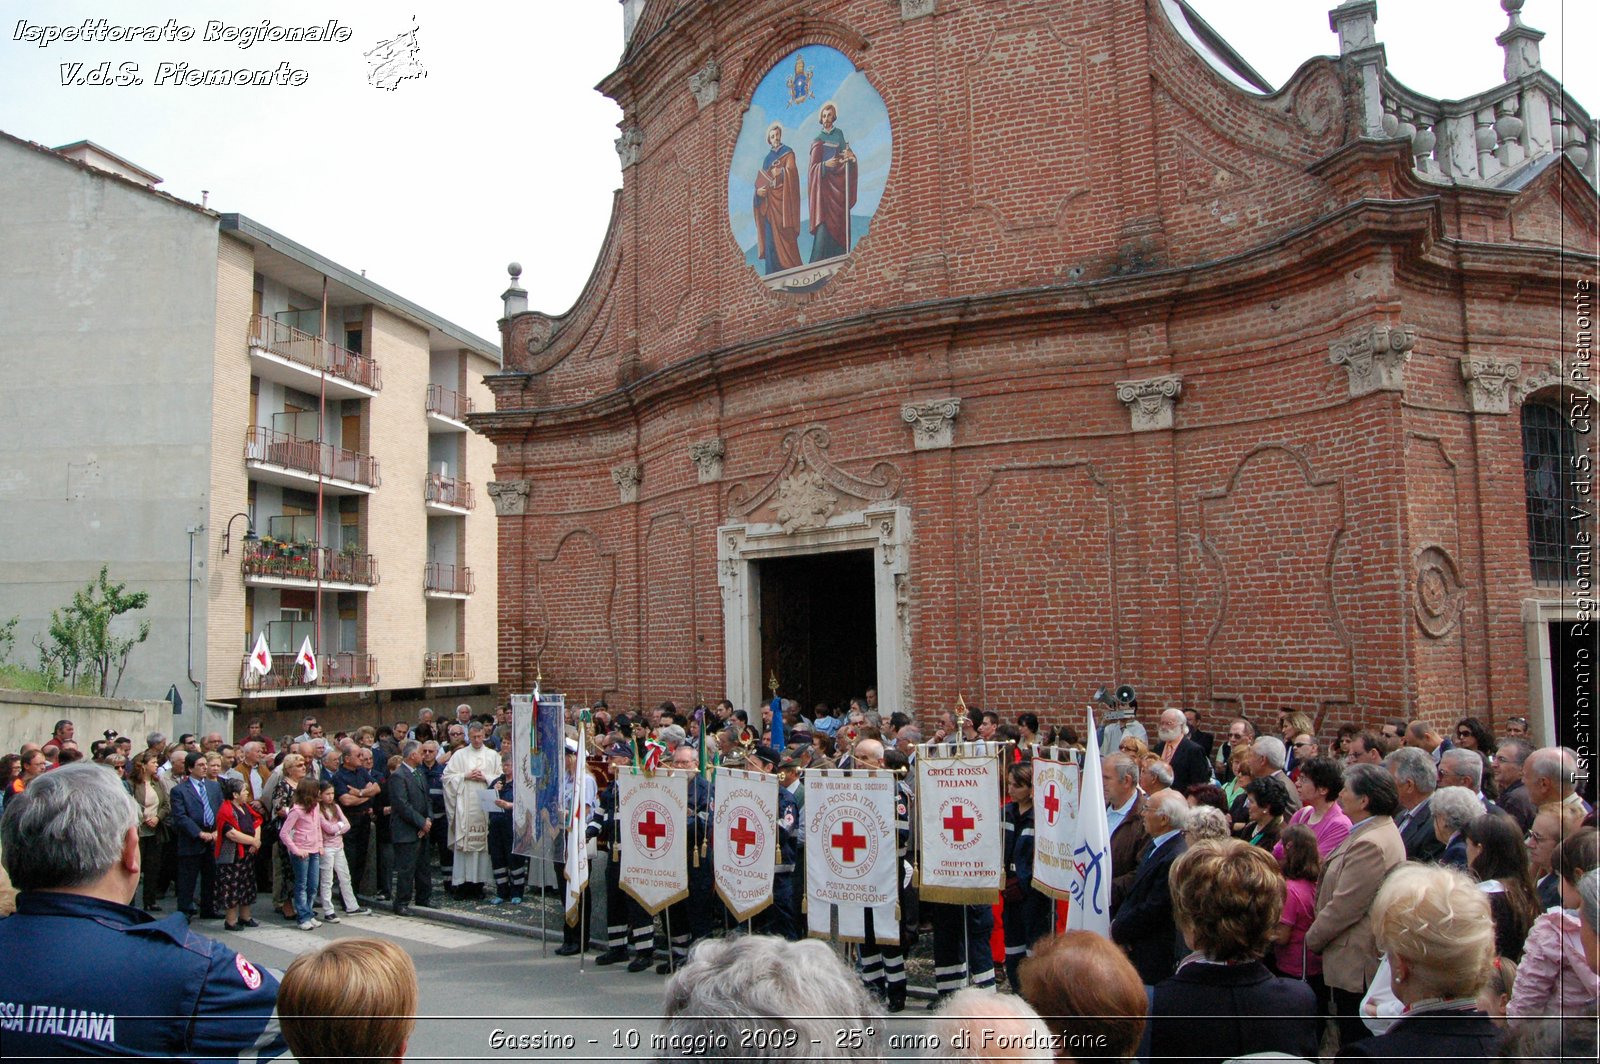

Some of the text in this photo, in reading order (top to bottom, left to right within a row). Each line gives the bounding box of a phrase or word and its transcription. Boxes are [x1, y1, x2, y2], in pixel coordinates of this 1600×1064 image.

[792, 271, 825, 286] D.O.M.
[927, 767, 988, 776] CROCE ROSSA
[853, 783, 863, 791] DEL
[937, 780, 978, 788] ITALIANA
[729, 789, 753, 800] ROSSA
[826, 792, 859, 805] ROSSA
[860, 795, 890, 839] ITALIANA
[950, 796, 983, 822] VOLONTARI
[950, 832, 982, 851] SOCCORSO
[941, 860, 972, 868] GRUPPO
[743, 869, 768, 880] LOCALE
[826, 880, 877, 893] POSTAZIONE DI
[816, 888, 888, 903] CASALBORGONE
[26, 1005, 115, 1042] ITALIANA
